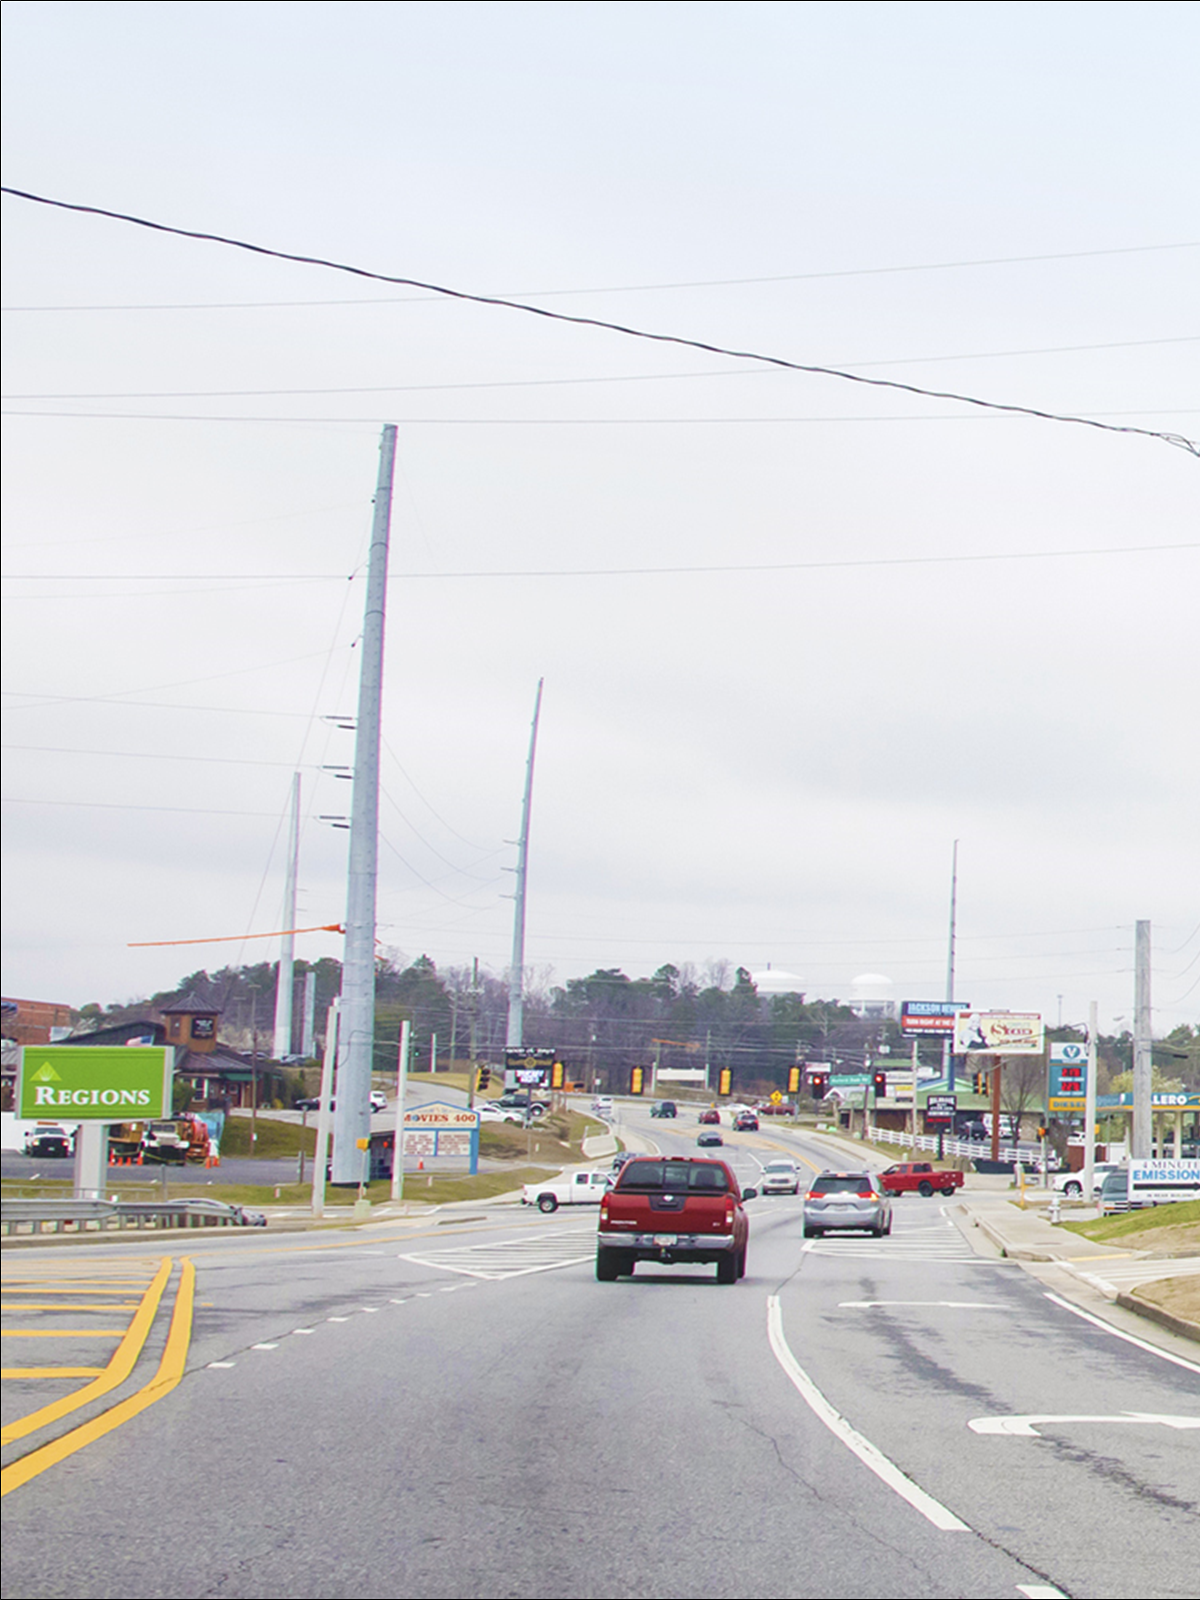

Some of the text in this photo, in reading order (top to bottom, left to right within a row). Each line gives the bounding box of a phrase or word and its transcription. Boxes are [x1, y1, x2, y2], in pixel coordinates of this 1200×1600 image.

[34, 1086, 151, 1106] REGIONS
[1152, 1094, 1188, 1105] LERO
[454, 1114, 476, 1122] 400
